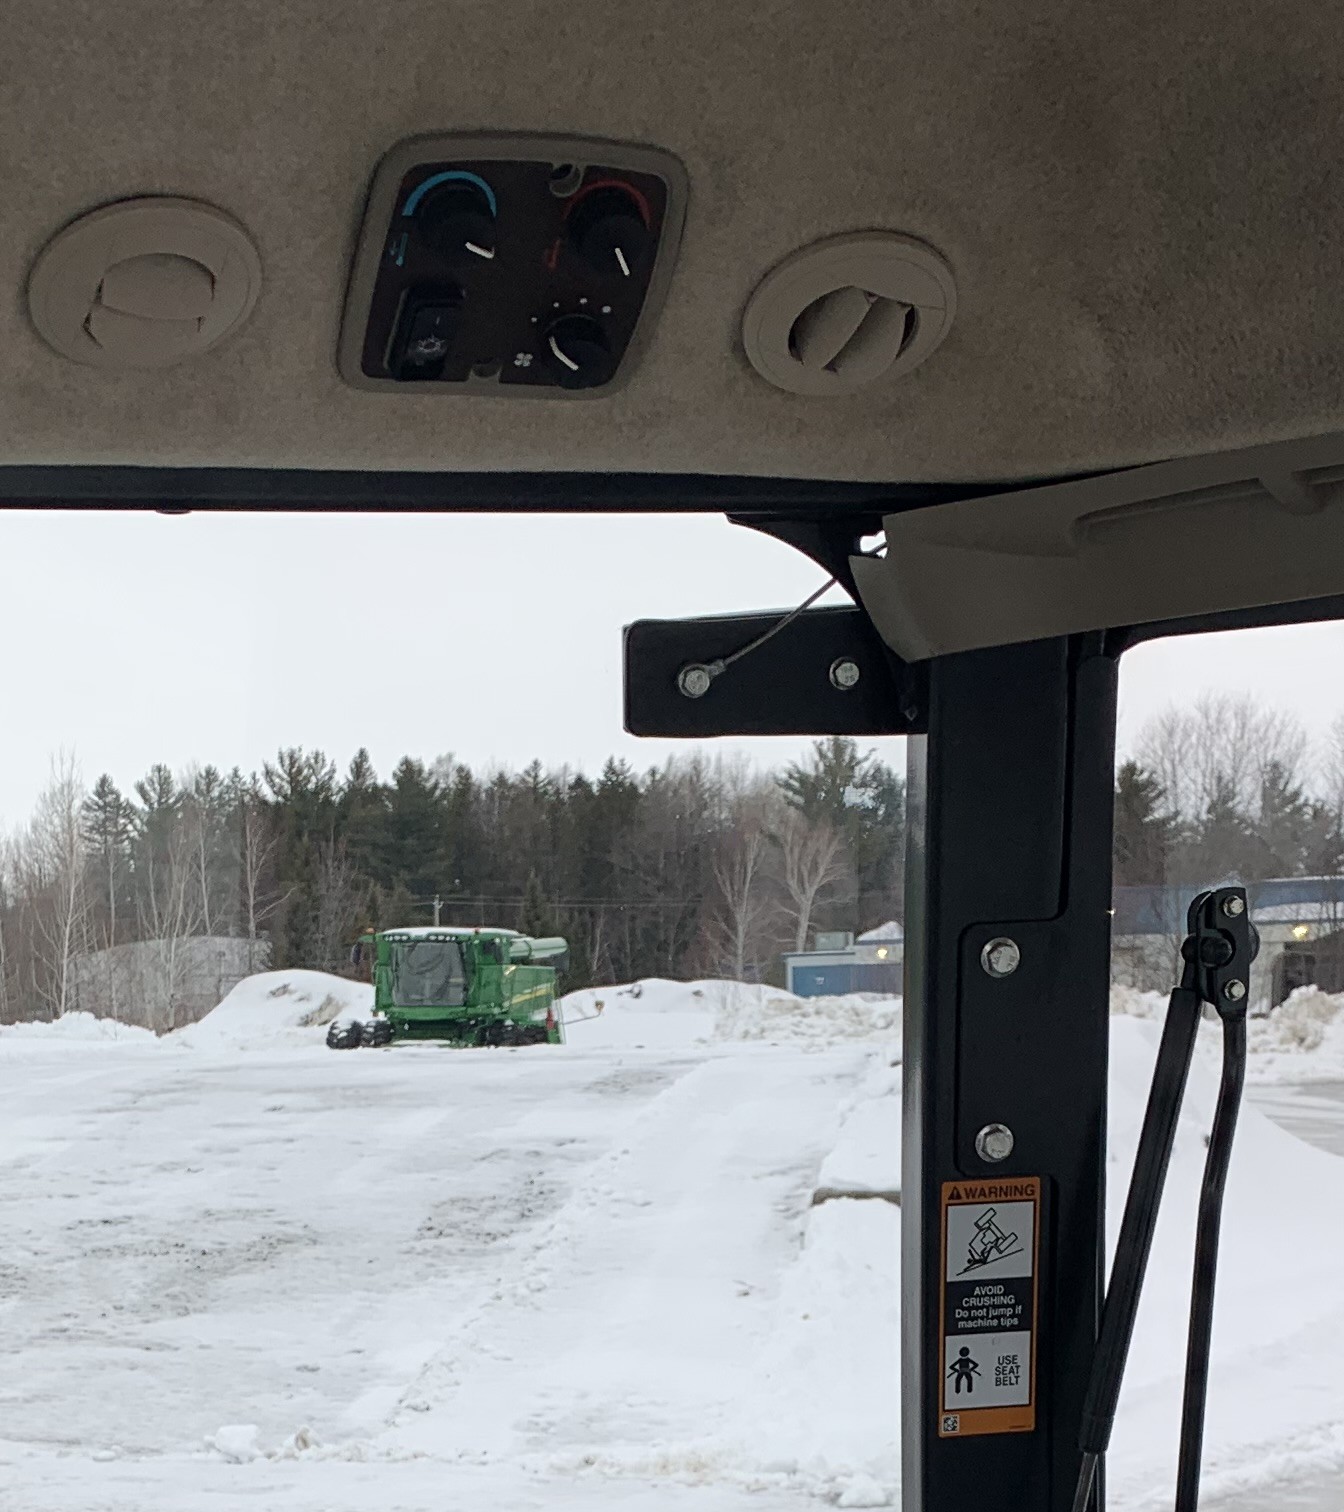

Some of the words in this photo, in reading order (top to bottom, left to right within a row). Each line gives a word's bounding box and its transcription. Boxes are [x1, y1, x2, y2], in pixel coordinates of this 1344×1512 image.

[964, 1184, 1035, 1199] WARNING
[973, 1285, 1004, 1296] AVOID
[962, 1295, 1015, 1307] CRUSHING
[955, 1309, 969, 1318] Do
[970, 1308, 987, 1317] not
[988, 1307, 1013, 1318] jump
[1015, 1305, 1022, 1314] if
[958, 1318, 998, 1328] machine
[1000, 1317, 1019, 1327] tips
[997, 1355, 1018, 1366] USE
[995, 1365, 1021, 1376] SEAT
[995, 1376, 1021, 1386] BELT
